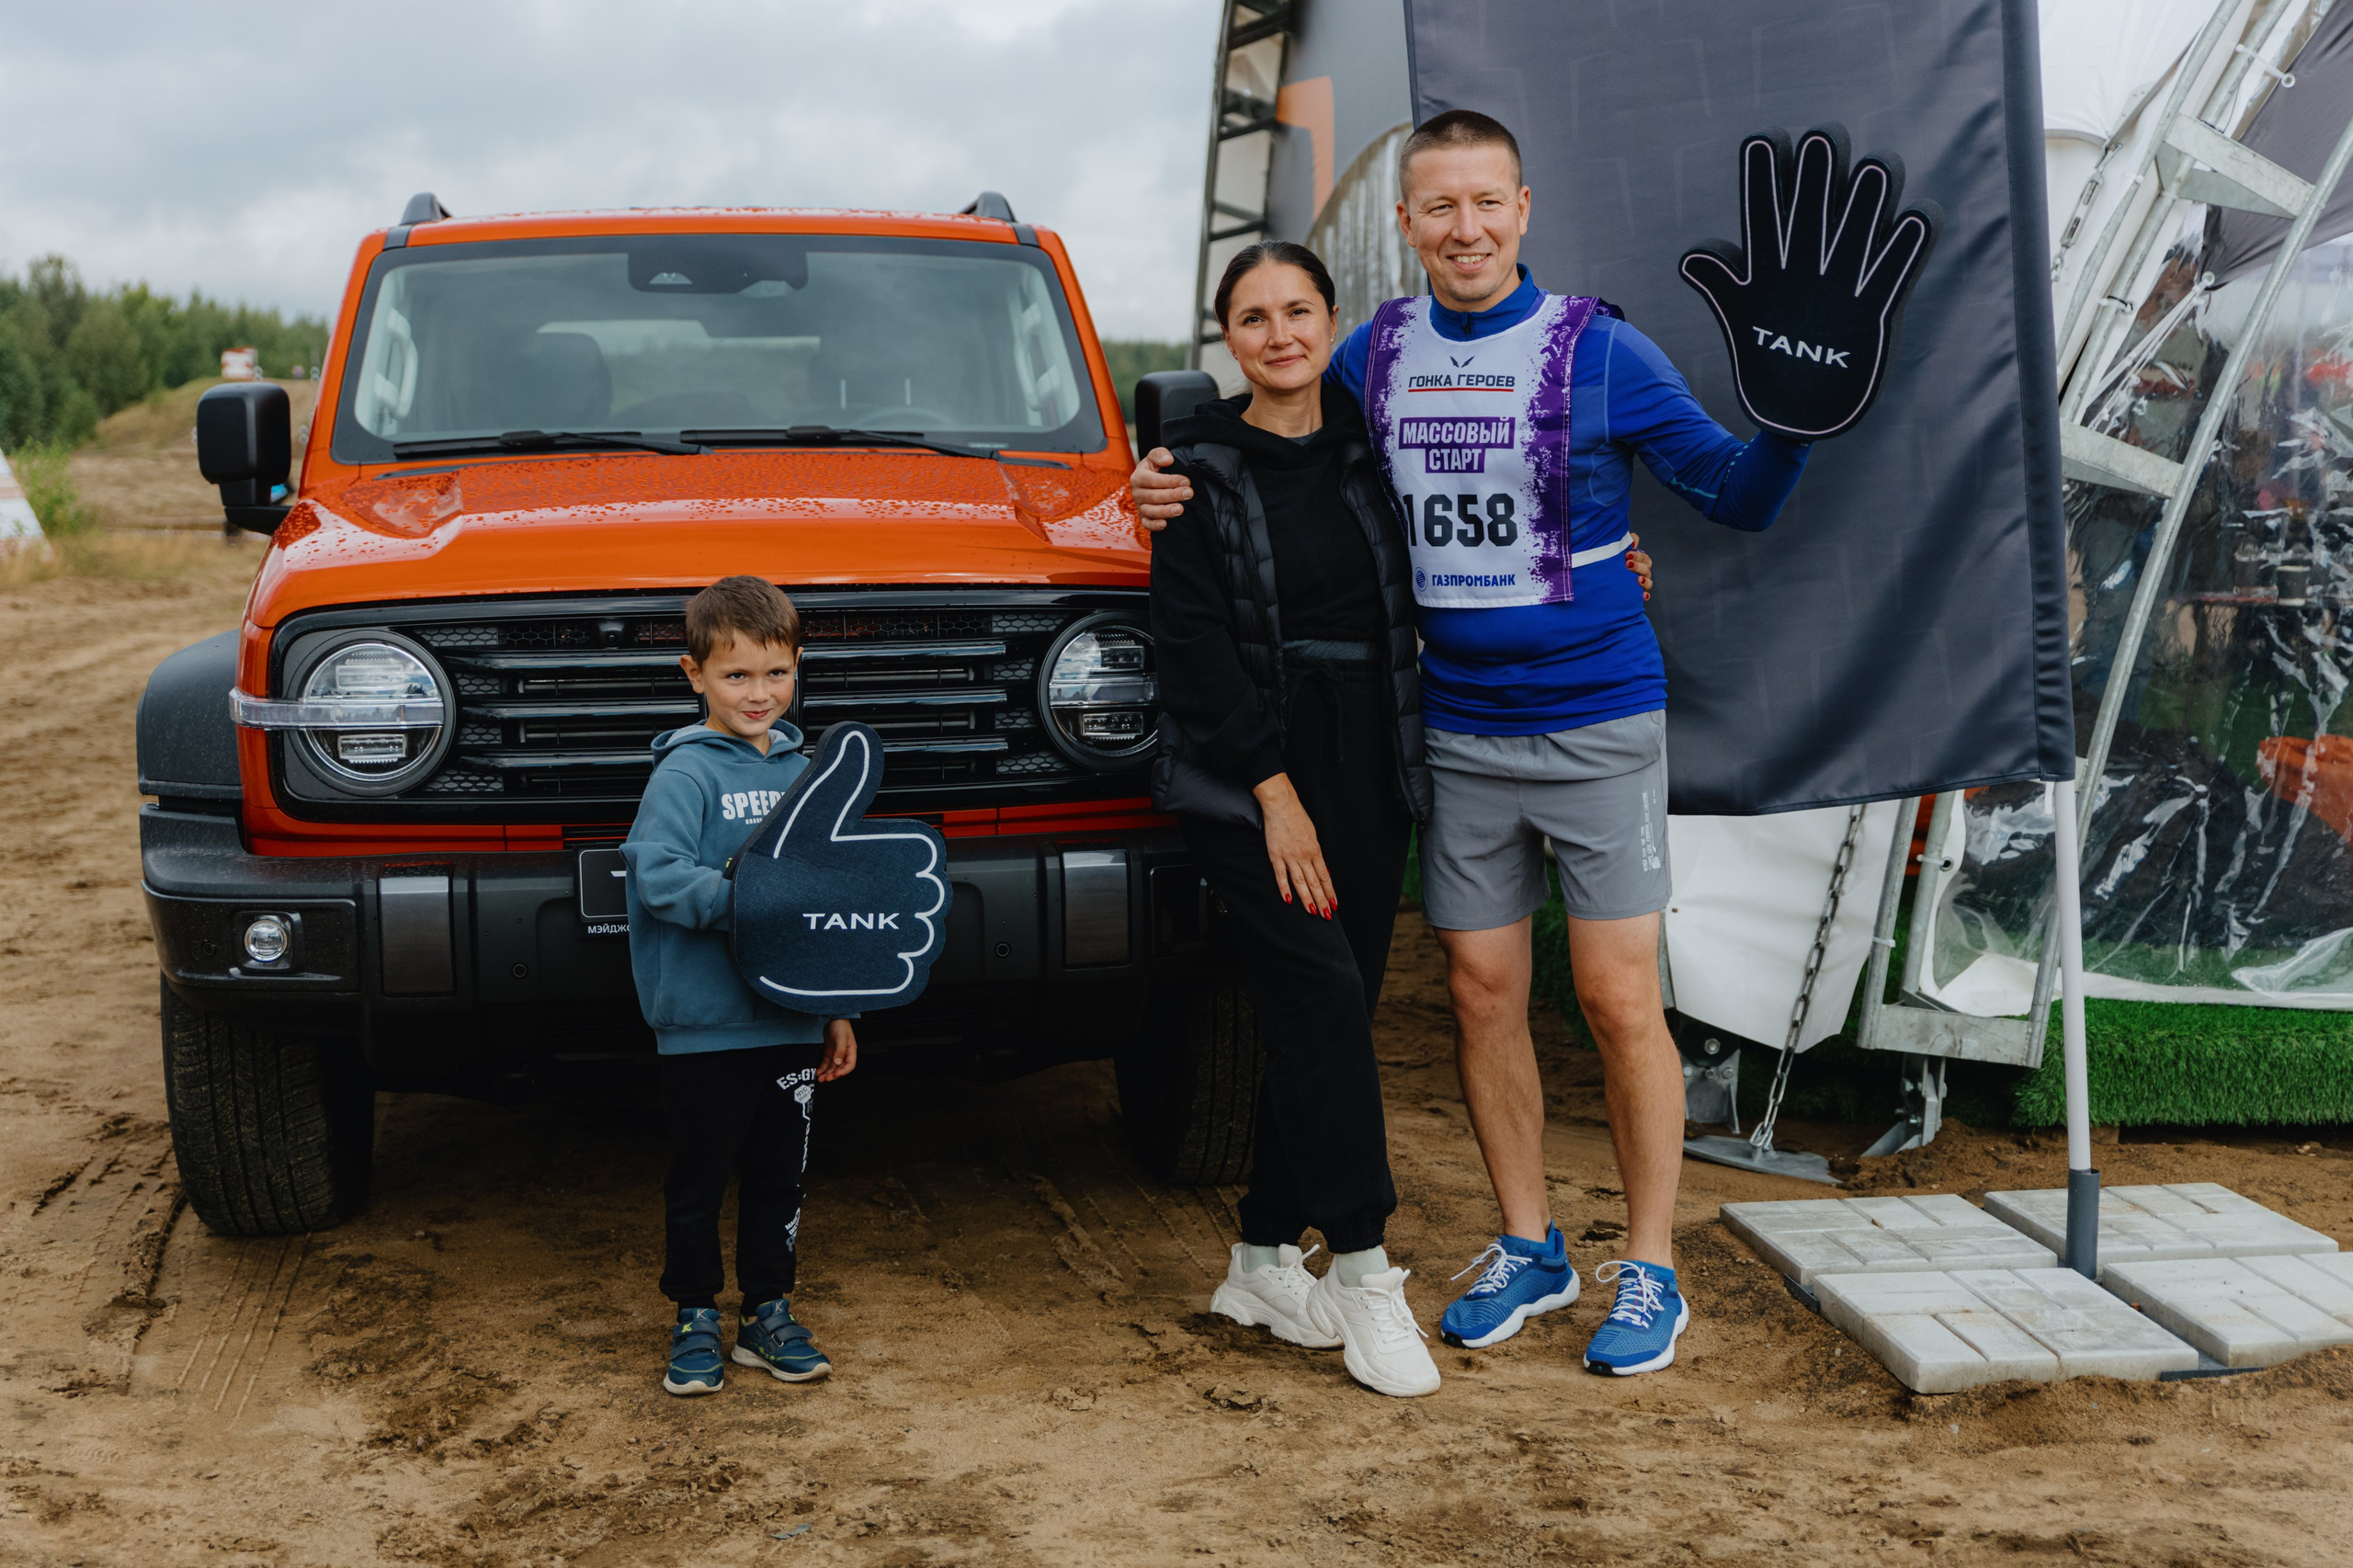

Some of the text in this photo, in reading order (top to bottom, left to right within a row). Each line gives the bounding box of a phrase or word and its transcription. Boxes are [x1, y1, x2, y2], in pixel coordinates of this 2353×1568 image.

[1752, 325, 1851, 368] TANK
[1408, 373, 1516, 388] ГОНКА ГЕРОЕВ
[1402, 416, 1510, 445] МАССОВЫЙ
[1427, 449, 1483, 472] СТАРТ
[1402, 493, 1519, 548] 1658
[1431, 573, 1517, 588] ГАЗПРОМБАНК
[721, 790, 786, 821] SPEED
[802, 912, 901, 930] TANK
